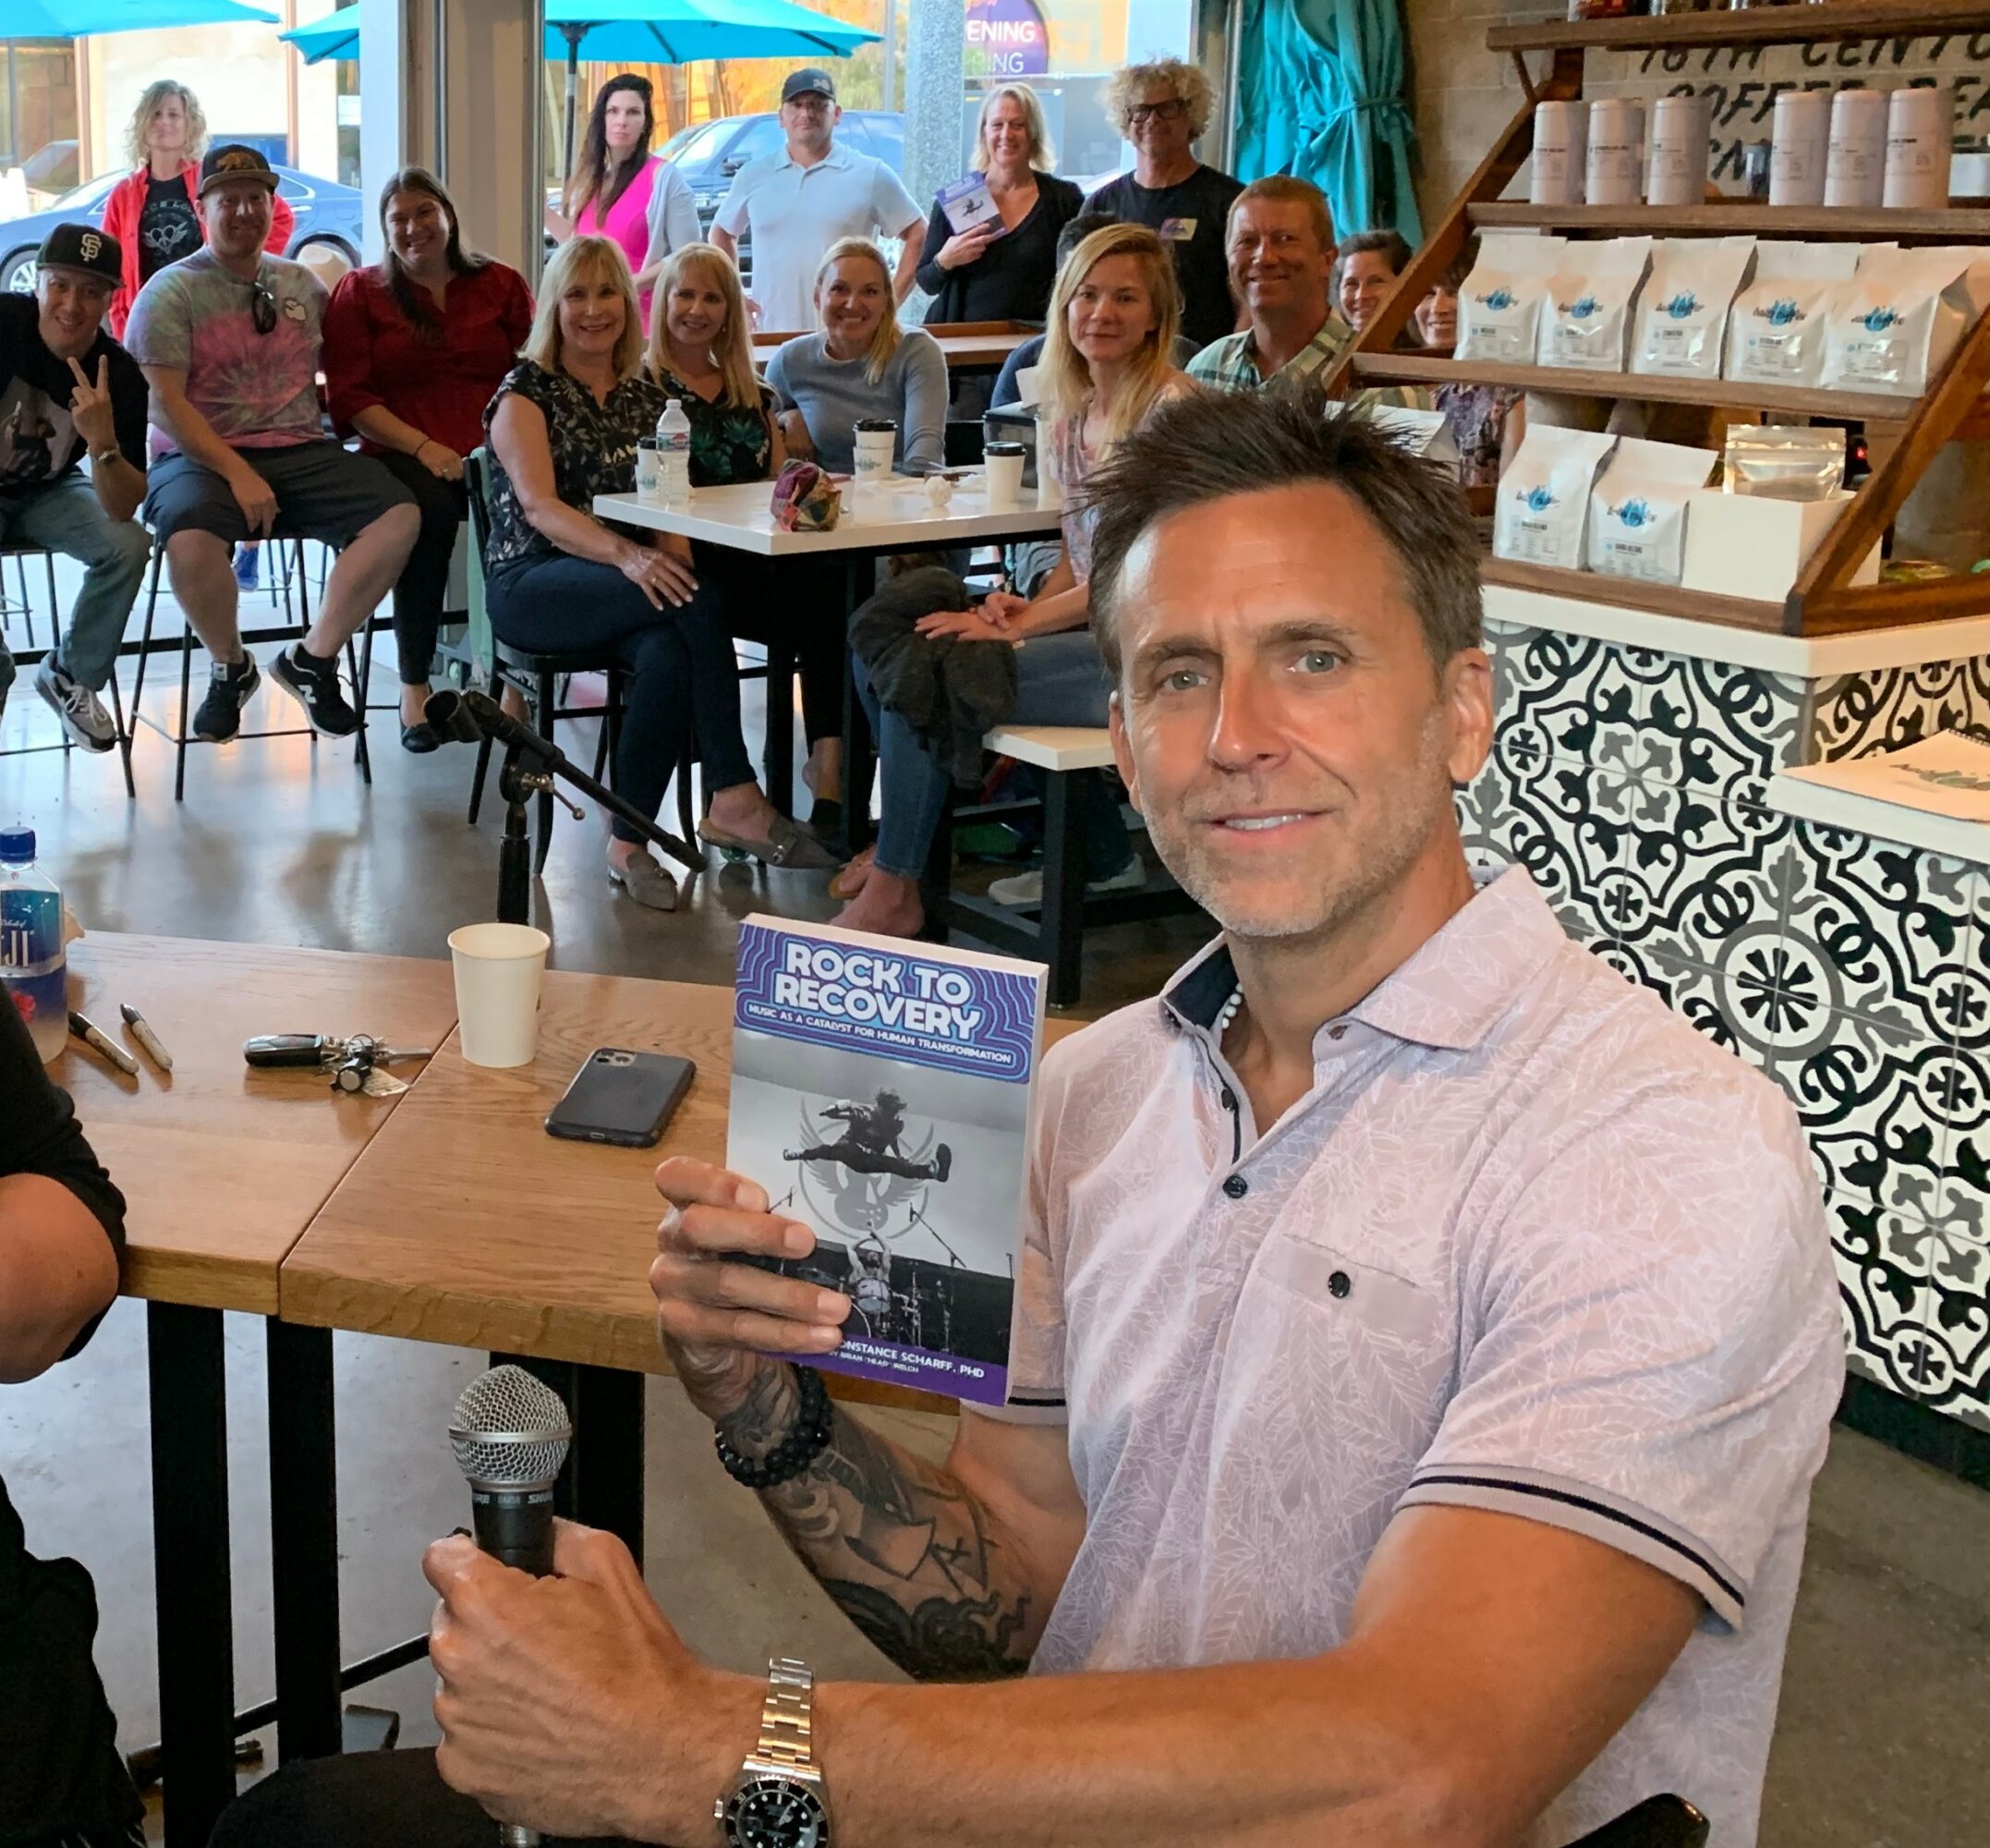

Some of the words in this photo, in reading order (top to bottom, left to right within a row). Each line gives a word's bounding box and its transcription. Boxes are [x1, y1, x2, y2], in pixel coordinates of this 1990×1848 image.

[787, 942, 902, 994] ROCK
[914, 967, 971, 1005] TO
[748, 1003, 778, 1019] MUSIC
[780, 1012, 794, 1022] AS
[795, 1015, 803, 1024] A
[806, 1016, 852, 1033] CATALYST
[855, 1026, 875, 1038] FOR
[878, 1030, 916, 1046] HUMAN
[918, 1038, 1012, 1064] TRANSFORMATION
[774, 973, 981, 1040] RECOVERY
[960, 1364, 985, 1379] PHD
